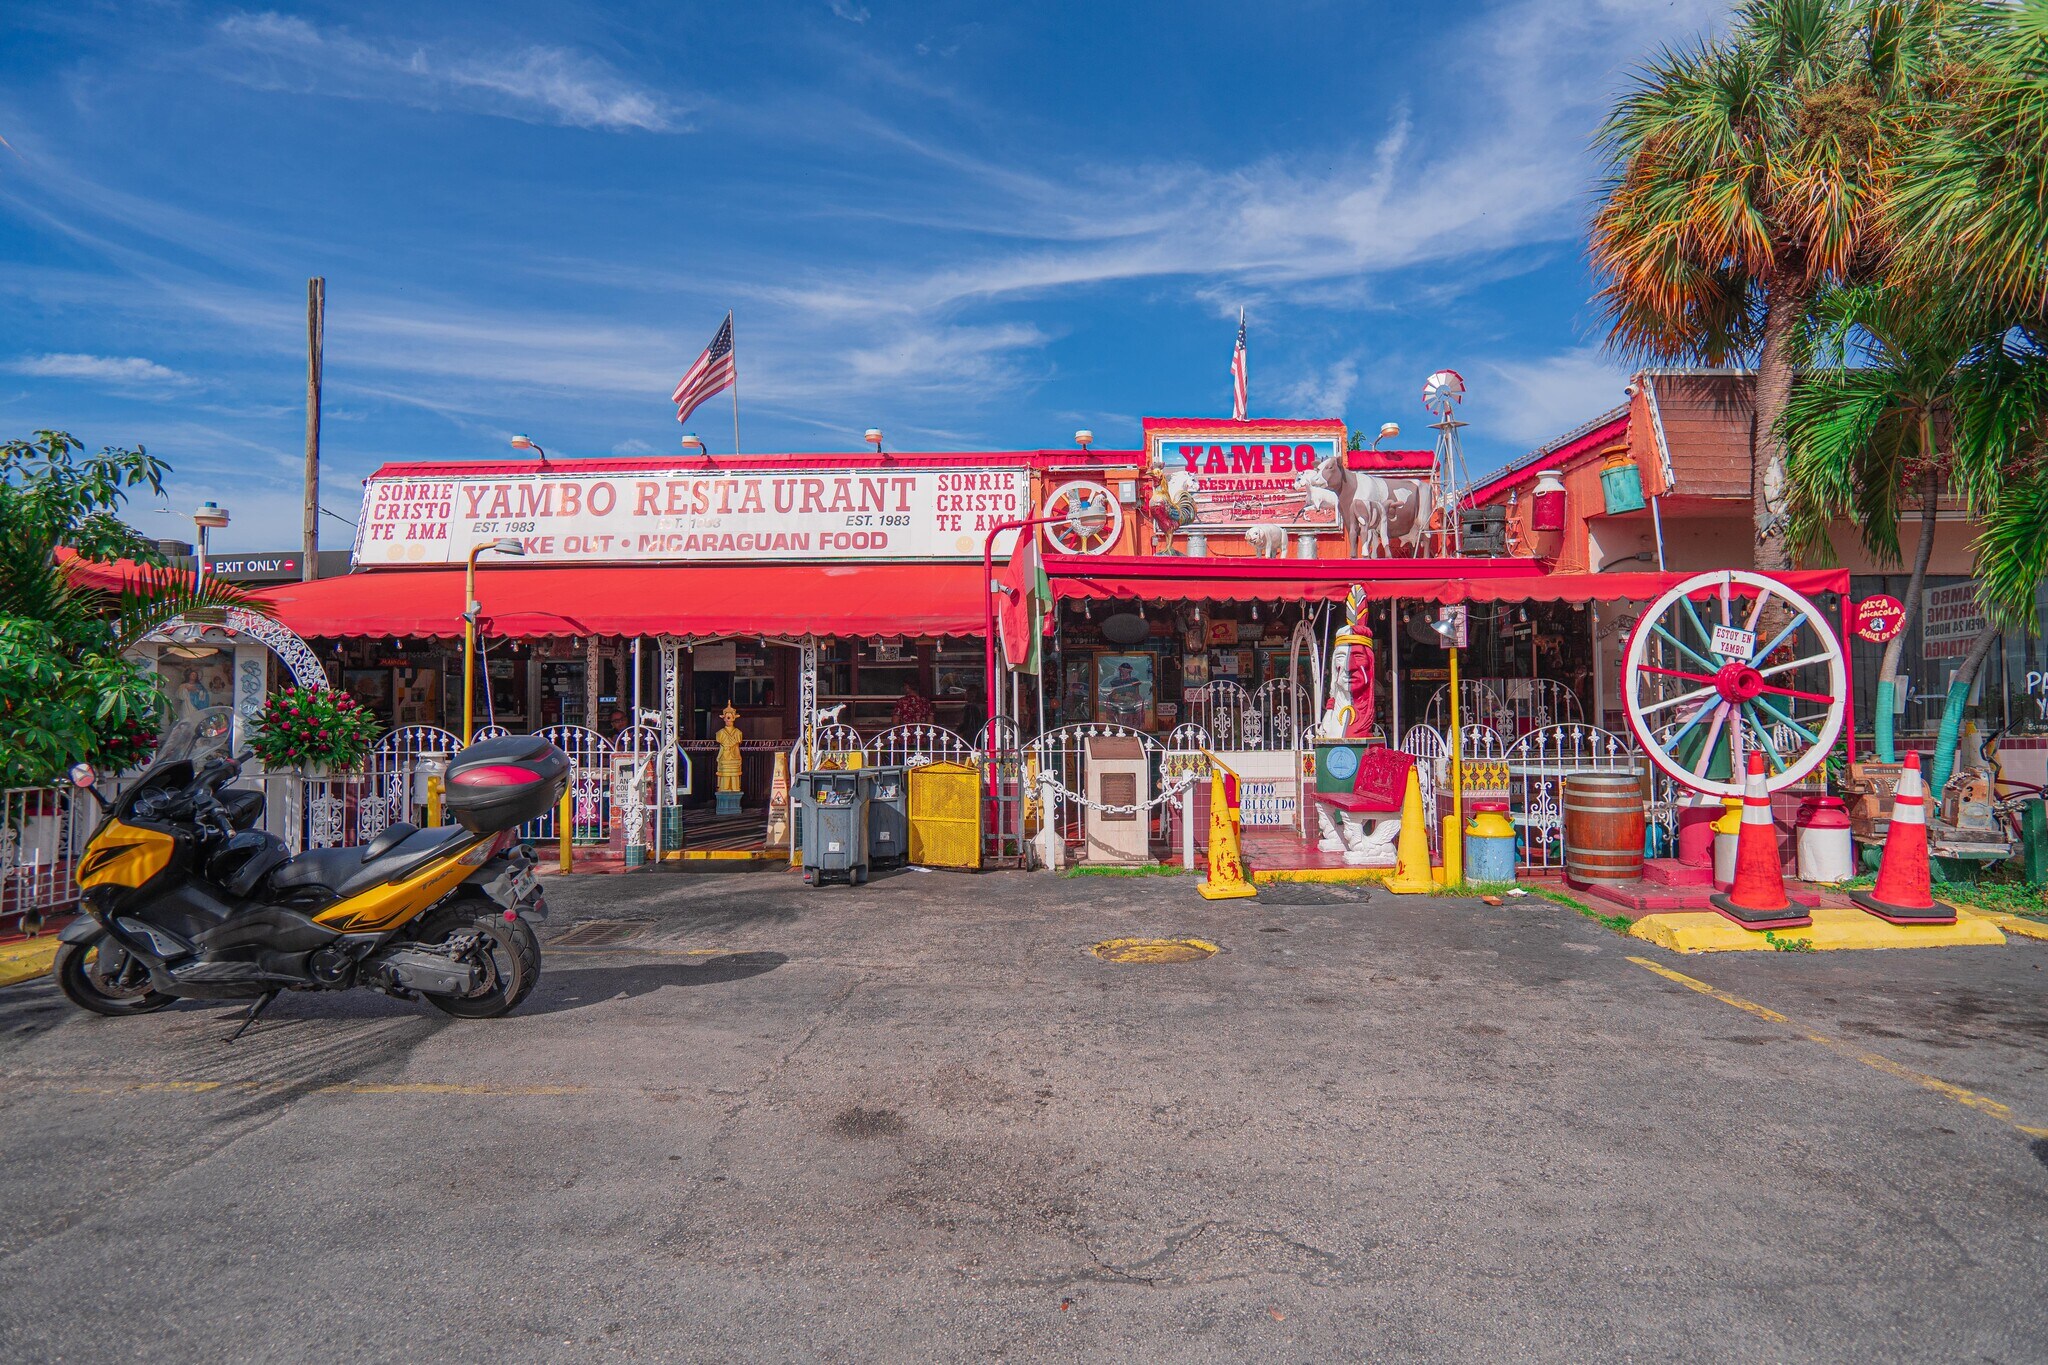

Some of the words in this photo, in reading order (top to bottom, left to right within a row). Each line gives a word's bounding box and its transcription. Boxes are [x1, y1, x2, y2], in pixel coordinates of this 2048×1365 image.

[1179, 444, 1316, 474] YAMBO
[937, 474, 1015, 492] SONRIE
[1198, 479, 1295, 491] RESTAURANT
[378, 484, 454, 502] SONRIE
[462, 482, 617, 519] YAMBO
[634, 476, 917, 517] RESTAURANT
[936, 493, 1017, 512] CRISTO
[373, 502, 452, 520] CRISTO
[472, 521, 500, 533] EST.
[504, 521, 535, 533] 1983
[846, 516, 873, 527] EST.
[879, 515, 911, 527] 1983
[936, 514, 963, 532] TE
[975, 514, 1019, 532] AMA
[370, 523, 395, 541] TE
[405, 523, 448, 541] AMA
[493, 536, 555, 555] KE
[563, 536, 614, 554] OUT
[638, 533, 811, 553] NICARAGUAN
[819, 531, 888, 551] FOOD
[216, 562, 244, 573] EXIT
[247, 560, 281, 572] ONLY
[1860, 599, 1888, 611] NICA
[1716, 629, 1739, 641] ESTOY
[1742, 633, 1752, 643] EN
[1858, 628, 1880, 641] AQUI
[1720, 642, 1745, 656] YAMBO
[1253, 814, 1280, 824] 1983
